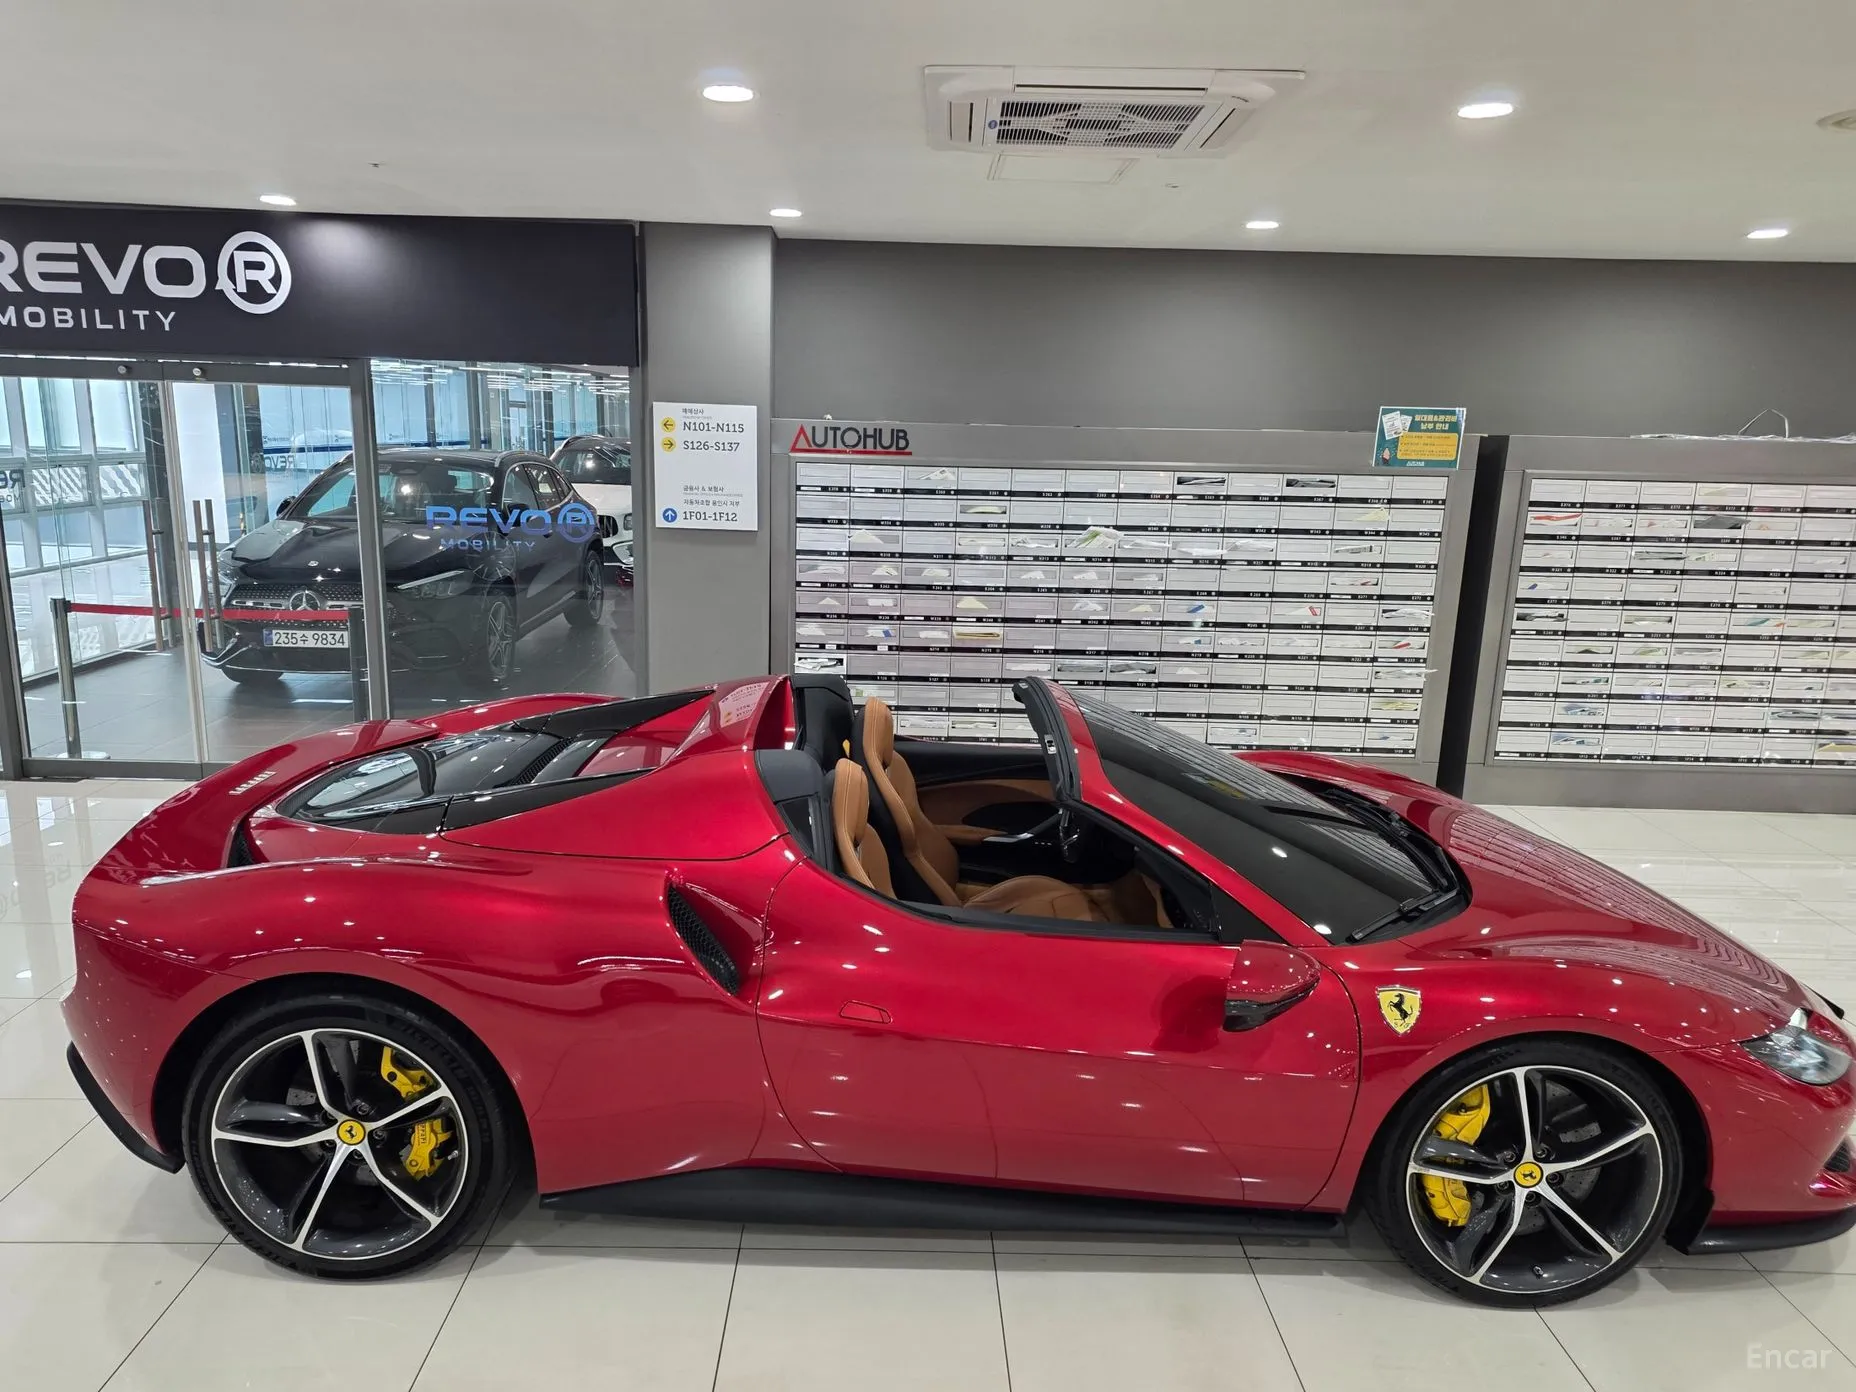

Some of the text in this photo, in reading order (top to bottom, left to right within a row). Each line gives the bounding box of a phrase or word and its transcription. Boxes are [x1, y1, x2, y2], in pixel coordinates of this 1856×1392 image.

[0, 305, 176, 331] MOBILITY
[683, 421, 744, 433] N101-N115
[789, 424, 910, 452] AUTOHUB
[683, 440, 740, 452] S126-S137
[425, 505, 551, 536] REVO
[683, 511, 738, 522] 1F01-1F12
[440, 538, 536, 551] MOBILITY
[274, 632, 345, 646] 235수 9834
